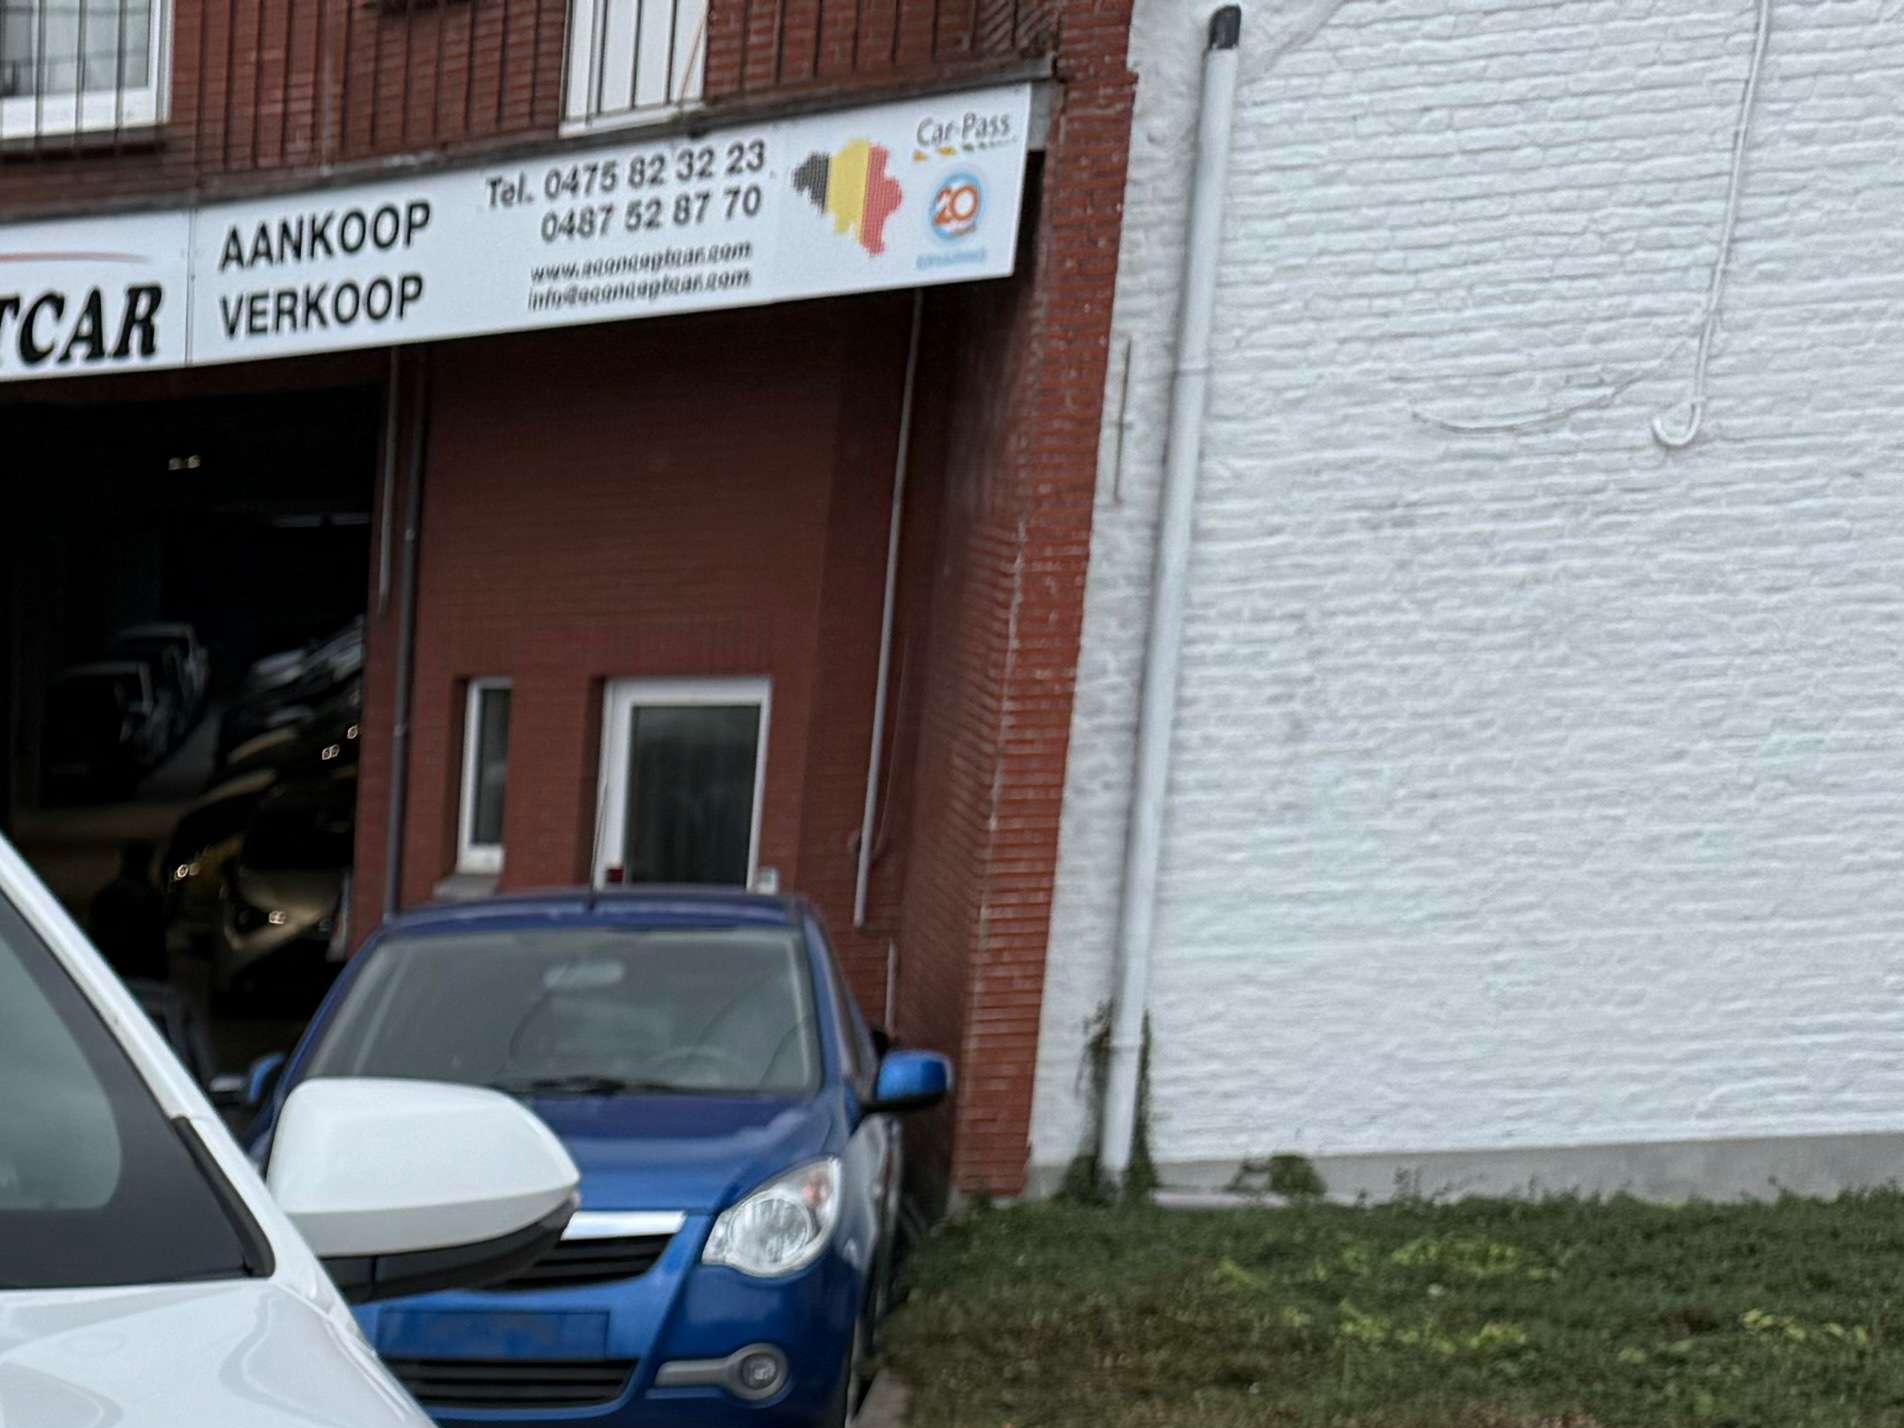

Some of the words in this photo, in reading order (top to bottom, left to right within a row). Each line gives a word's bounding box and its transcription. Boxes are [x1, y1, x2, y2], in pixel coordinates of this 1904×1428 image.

[486, 173, 535, 208] Tel.
[543, 161, 618, 200] 0475
[627, 154, 667, 190] 82
[676, 147, 716, 181] 32
[726, 140, 766, 175] 23
[219, 200, 432, 272] AANKOOP
[540, 204, 615, 243] 0487
[624, 197, 663, 232] 52
[672, 191, 712, 226] 87
[724, 185, 762, 219] 70
[220, 273, 425, 340] VERKOOP
